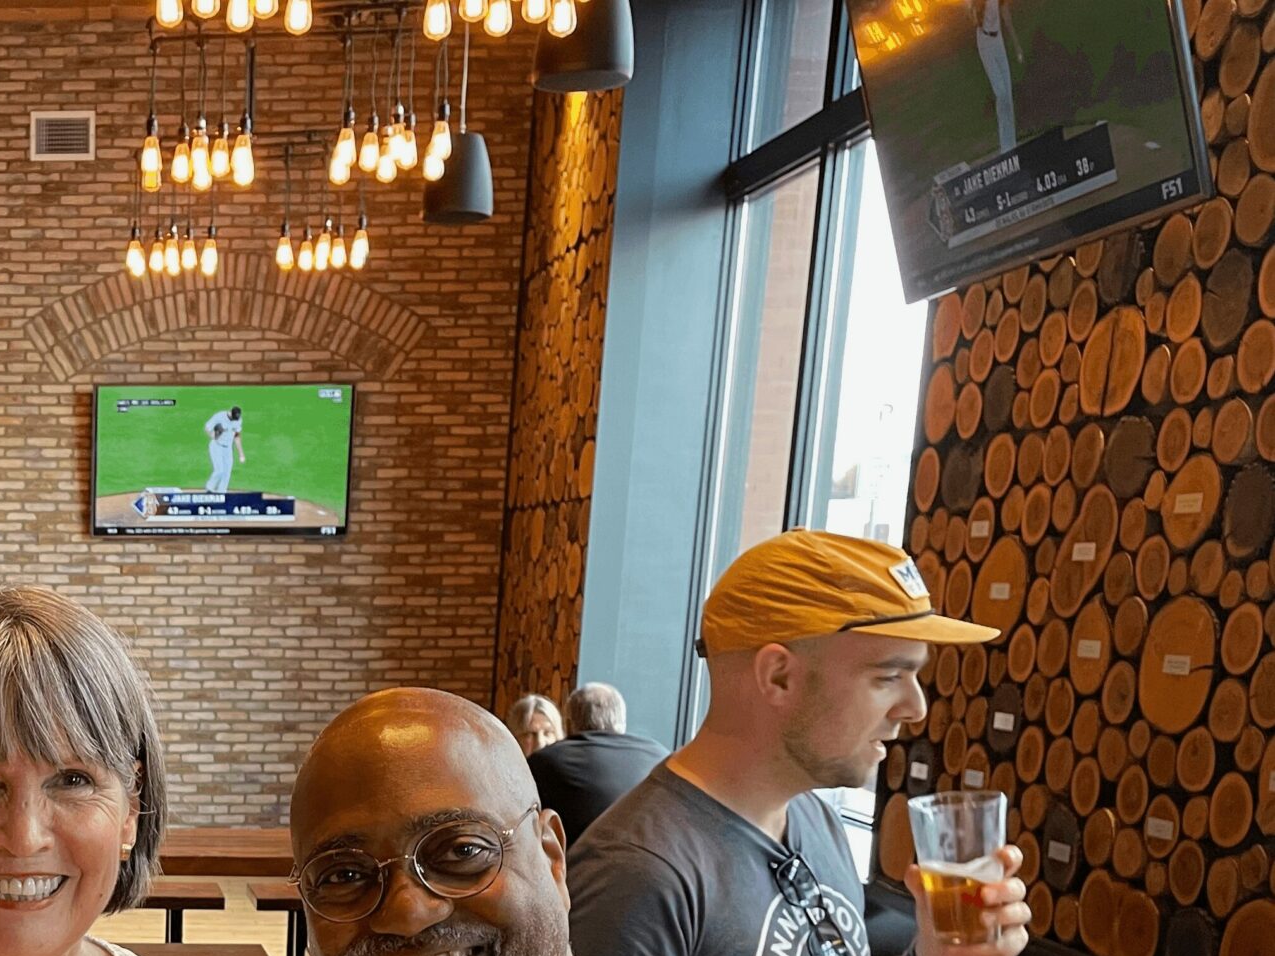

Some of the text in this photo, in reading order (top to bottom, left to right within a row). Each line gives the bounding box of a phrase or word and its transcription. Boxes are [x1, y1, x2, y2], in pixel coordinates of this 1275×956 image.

[962, 172, 984, 195] JAKE
[983, 154, 1021, 186] DIEKMAN
[1161, 176, 1184, 201] FS1
